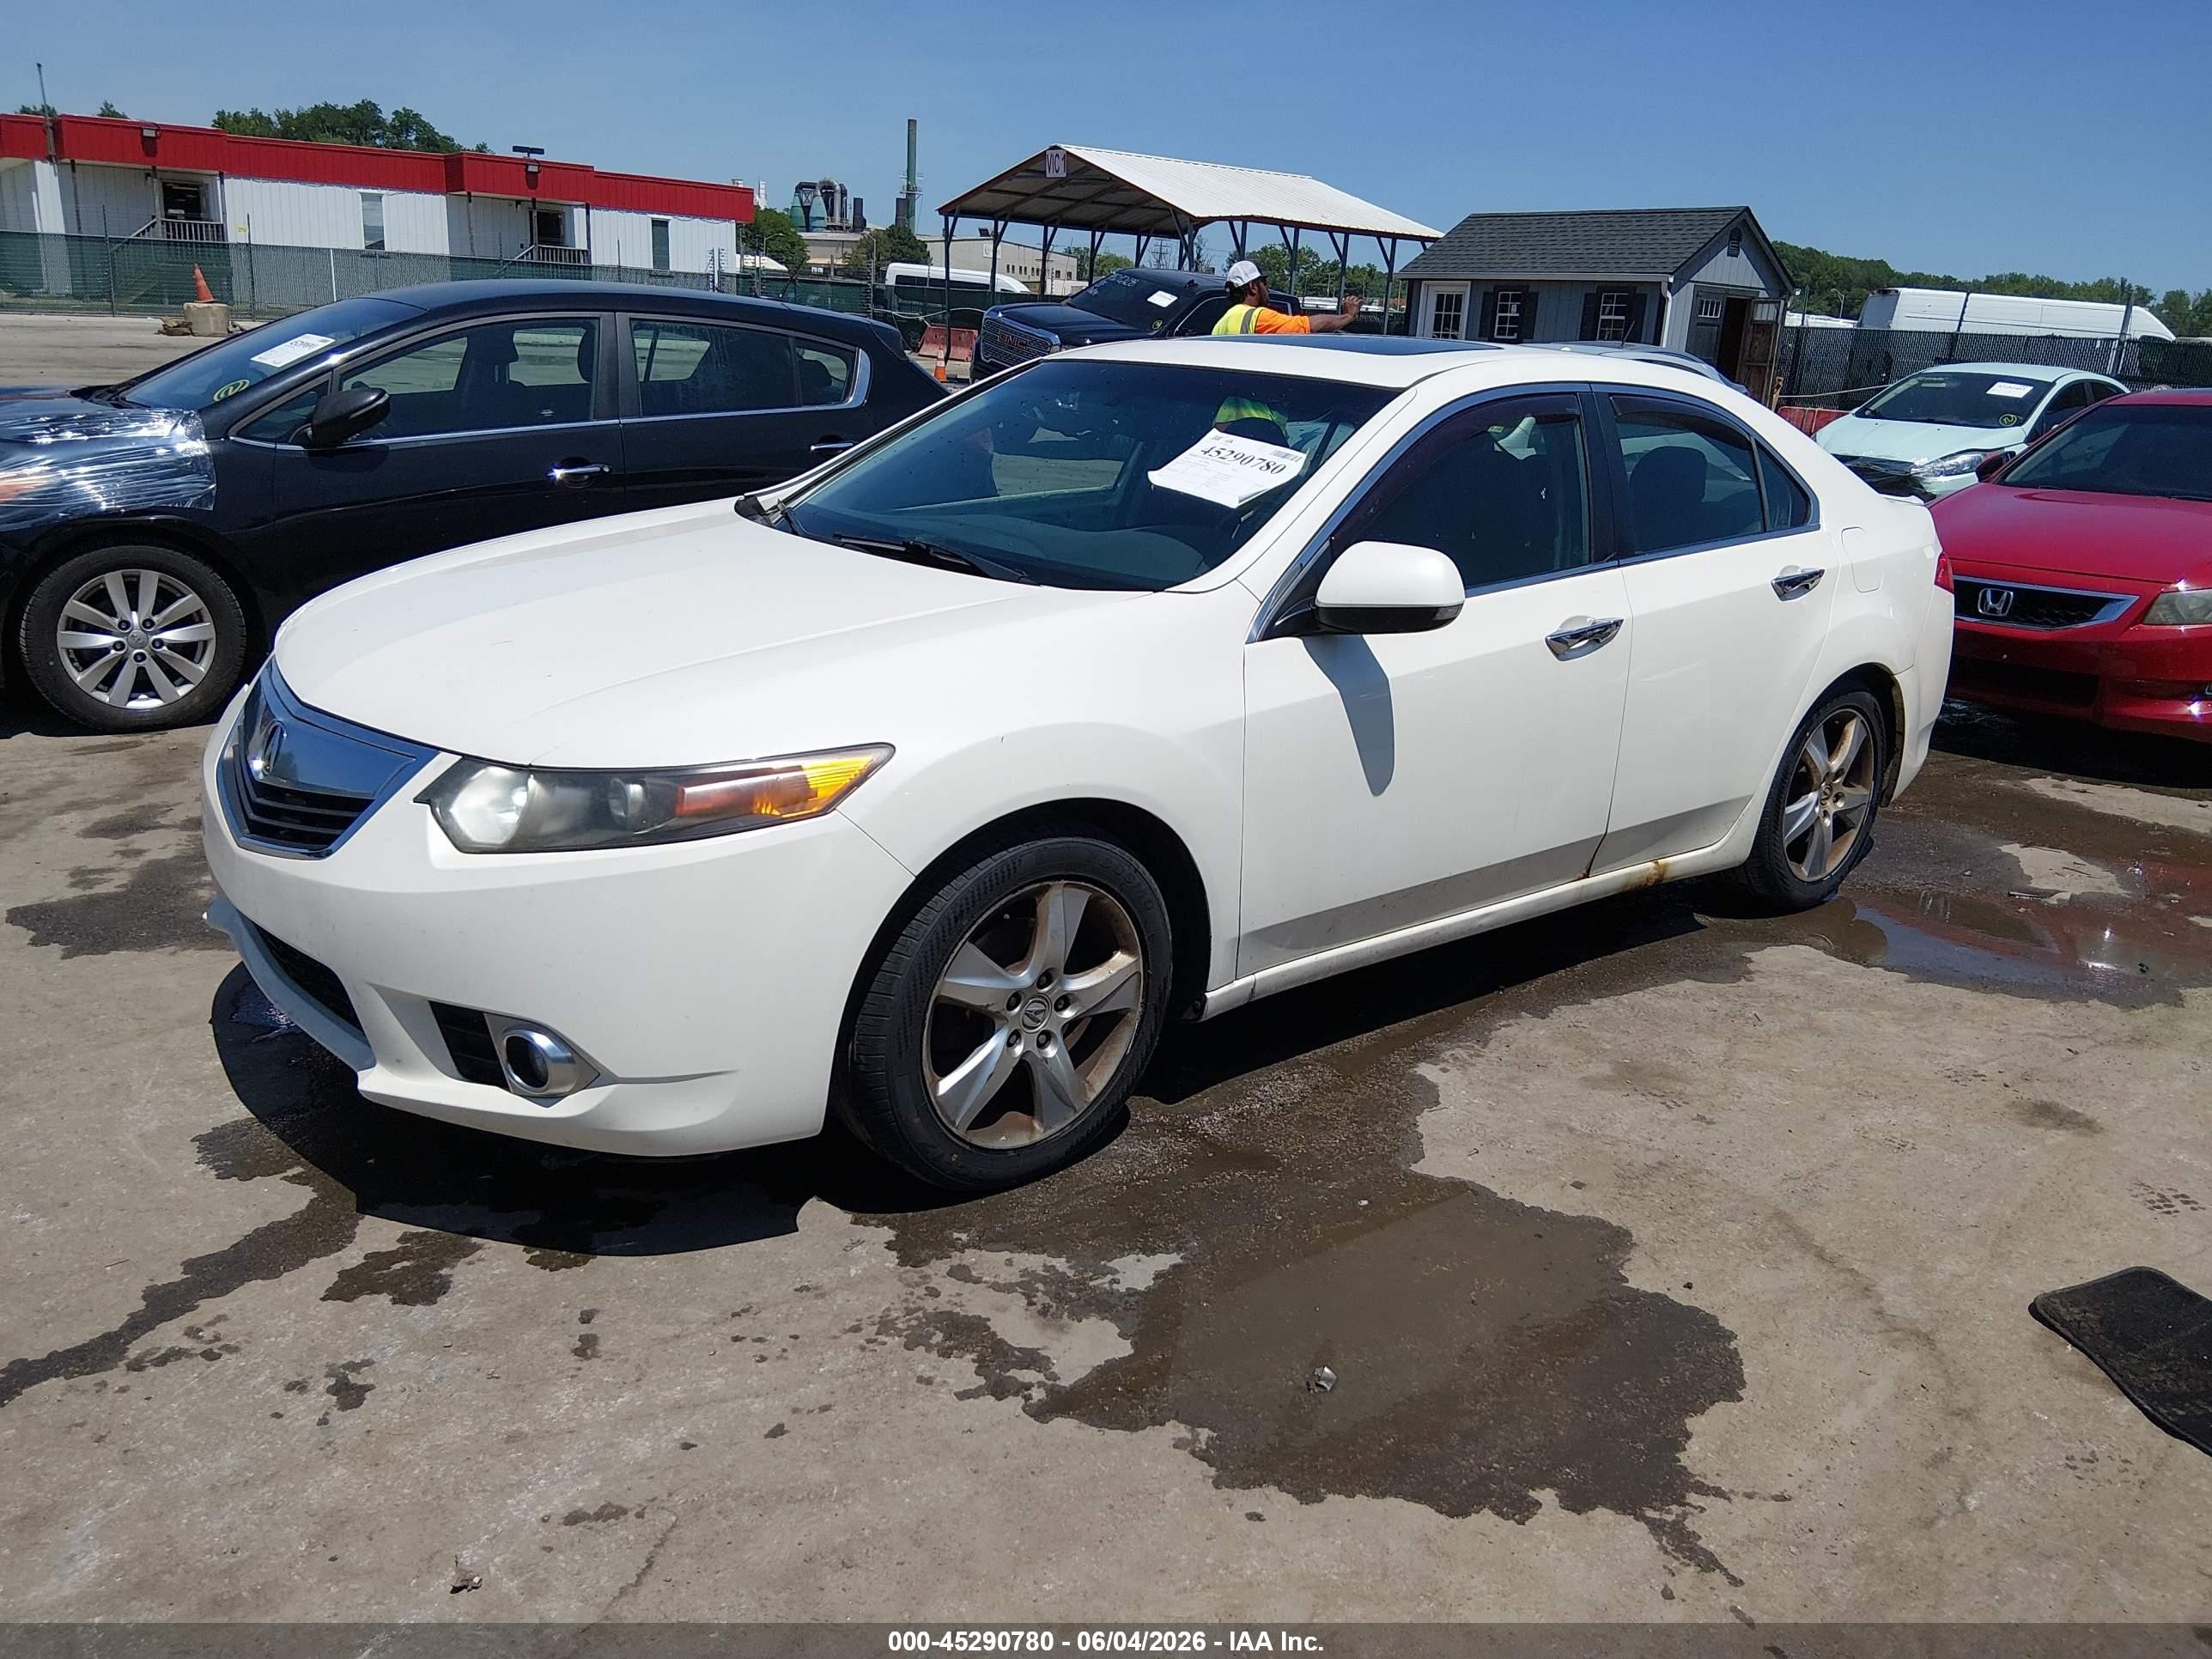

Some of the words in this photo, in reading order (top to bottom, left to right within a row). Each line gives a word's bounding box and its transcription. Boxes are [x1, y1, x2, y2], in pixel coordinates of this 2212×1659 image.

[1047, 154, 1060, 173] VIC
[1060, 154, 1066, 173] 1
[1200, 446, 1286, 474] 45290780
